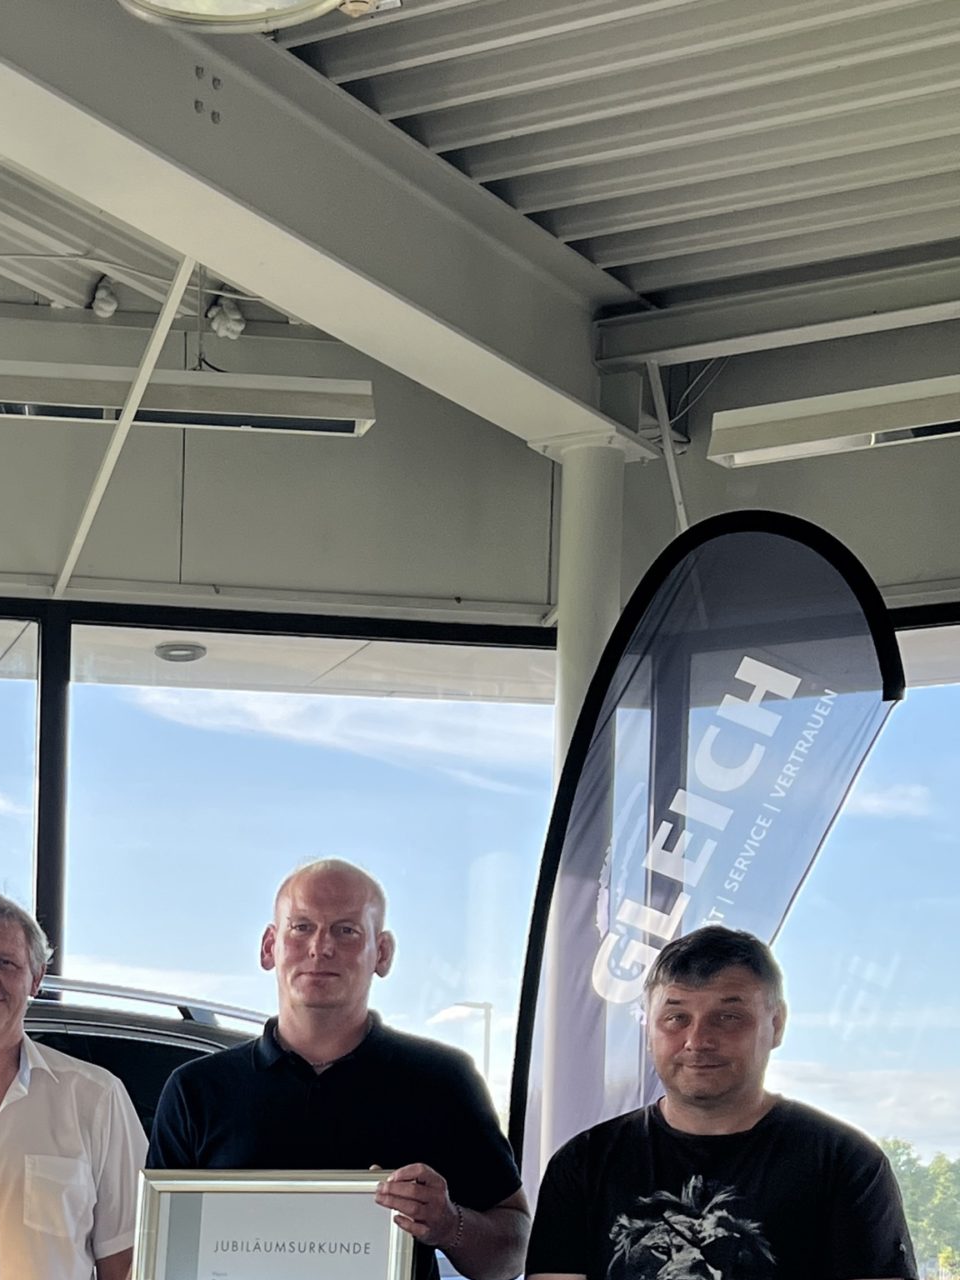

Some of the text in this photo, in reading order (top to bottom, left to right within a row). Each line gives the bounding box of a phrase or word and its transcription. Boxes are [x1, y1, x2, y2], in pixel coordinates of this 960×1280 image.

[592, 655, 803, 1004] GLEICH
[724, 813, 773, 893] SERVICE
[769, 688, 839, 800] VERTRAUEN
[214, 1238, 371, 1255] JUBILÄUMSURKUNDE
